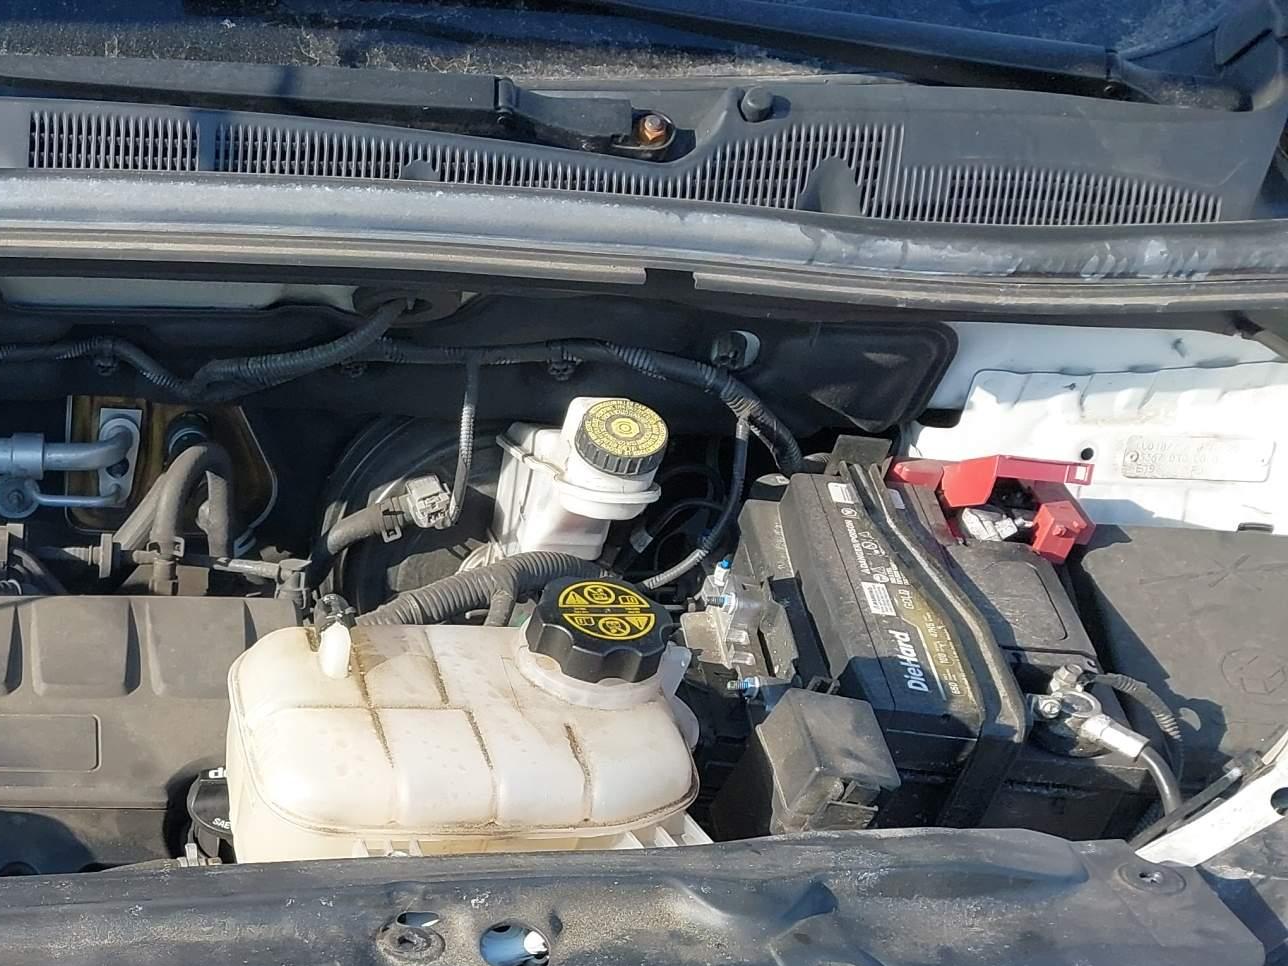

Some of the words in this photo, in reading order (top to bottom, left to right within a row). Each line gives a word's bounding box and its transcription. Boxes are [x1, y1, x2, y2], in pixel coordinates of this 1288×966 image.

[898, 589, 915, 610] GOLD
[888, 629, 929, 693] DieHard
[212, 817, 231, 830] SAE
